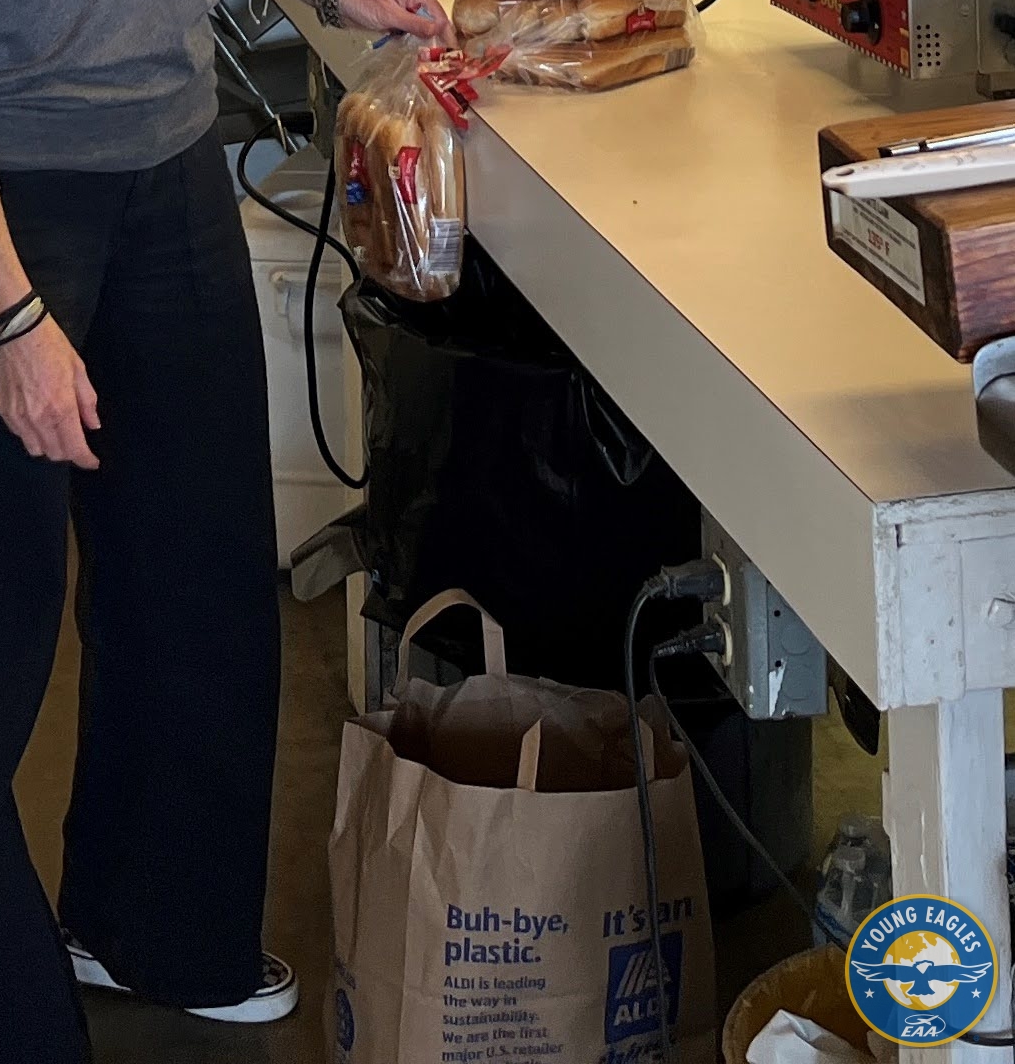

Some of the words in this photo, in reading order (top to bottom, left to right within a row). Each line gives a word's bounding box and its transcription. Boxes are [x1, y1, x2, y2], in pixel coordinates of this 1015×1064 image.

[446, 903, 569, 940] Buh-bye,
[603, 904, 646, 938] It's
[444, 937, 542, 967] plastic.
[443, 975, 475, 989] ALDI
[478, 976, 490, 989] is
[493, 976, 546, 991] leading
[443, 994, 467, 1008] the
[470, 996, 500, 1009] way
[503, 994, 517, 1006] in
[442, 1031, 463, 1043] We
[466, 1031, 489, 1043] are
[492, 1027, 516, 1040] the
[519, 1026, 548, 1039] first
[442, 1048, 485, 1063] major
